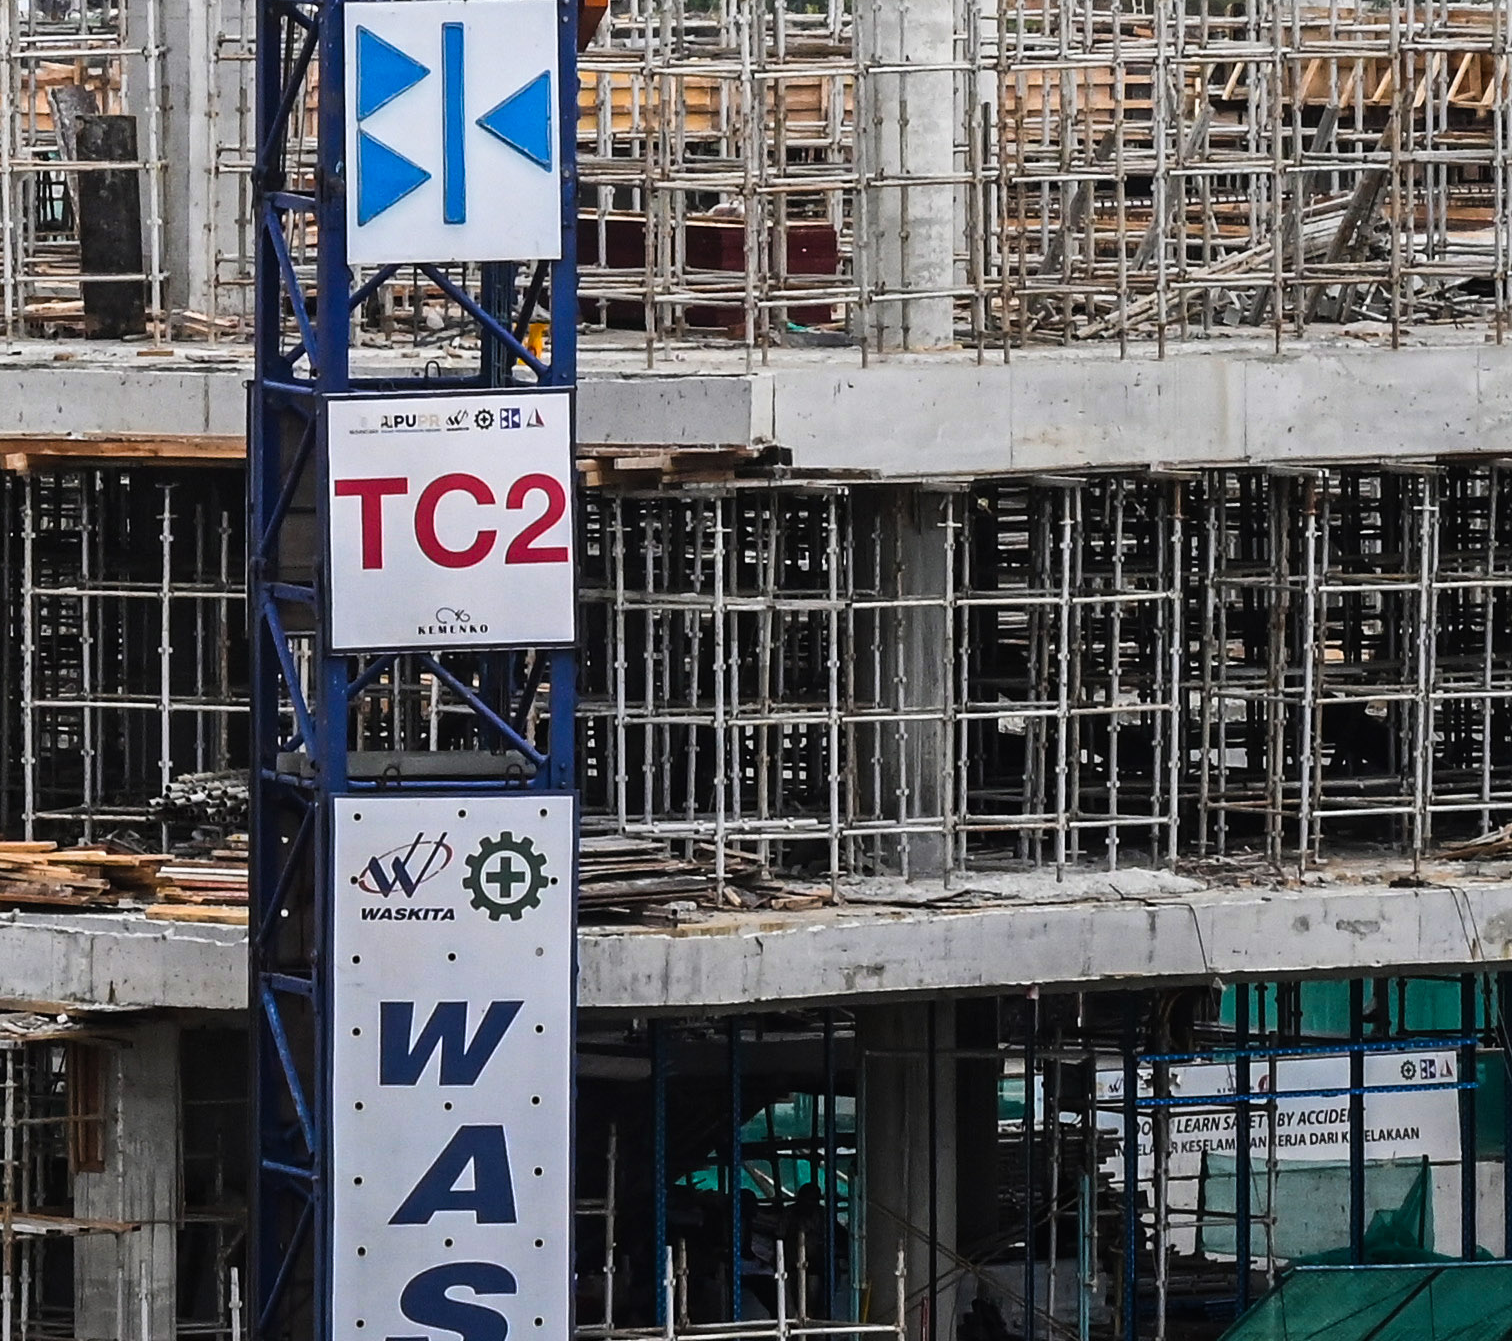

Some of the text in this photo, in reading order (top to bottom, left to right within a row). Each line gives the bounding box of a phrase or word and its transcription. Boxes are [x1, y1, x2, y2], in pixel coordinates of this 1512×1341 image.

[335, 473, 568, 570] TC2
[418, 624, 488, 636] KEMENKO
[361, 908, 455, 921] WASKITA
[1177, 1117, 1219, 1134] LEARN
[1277, 1111, 1295, 1128] BY
[1297, 1108, 1365, 1126] ACCIDE
[1277, 1132, 1307, 1147] ERJA
[1310, 1131, 1339, 1145] DARI
[1341, 1126, 1420, 1144] KELAKAAN
